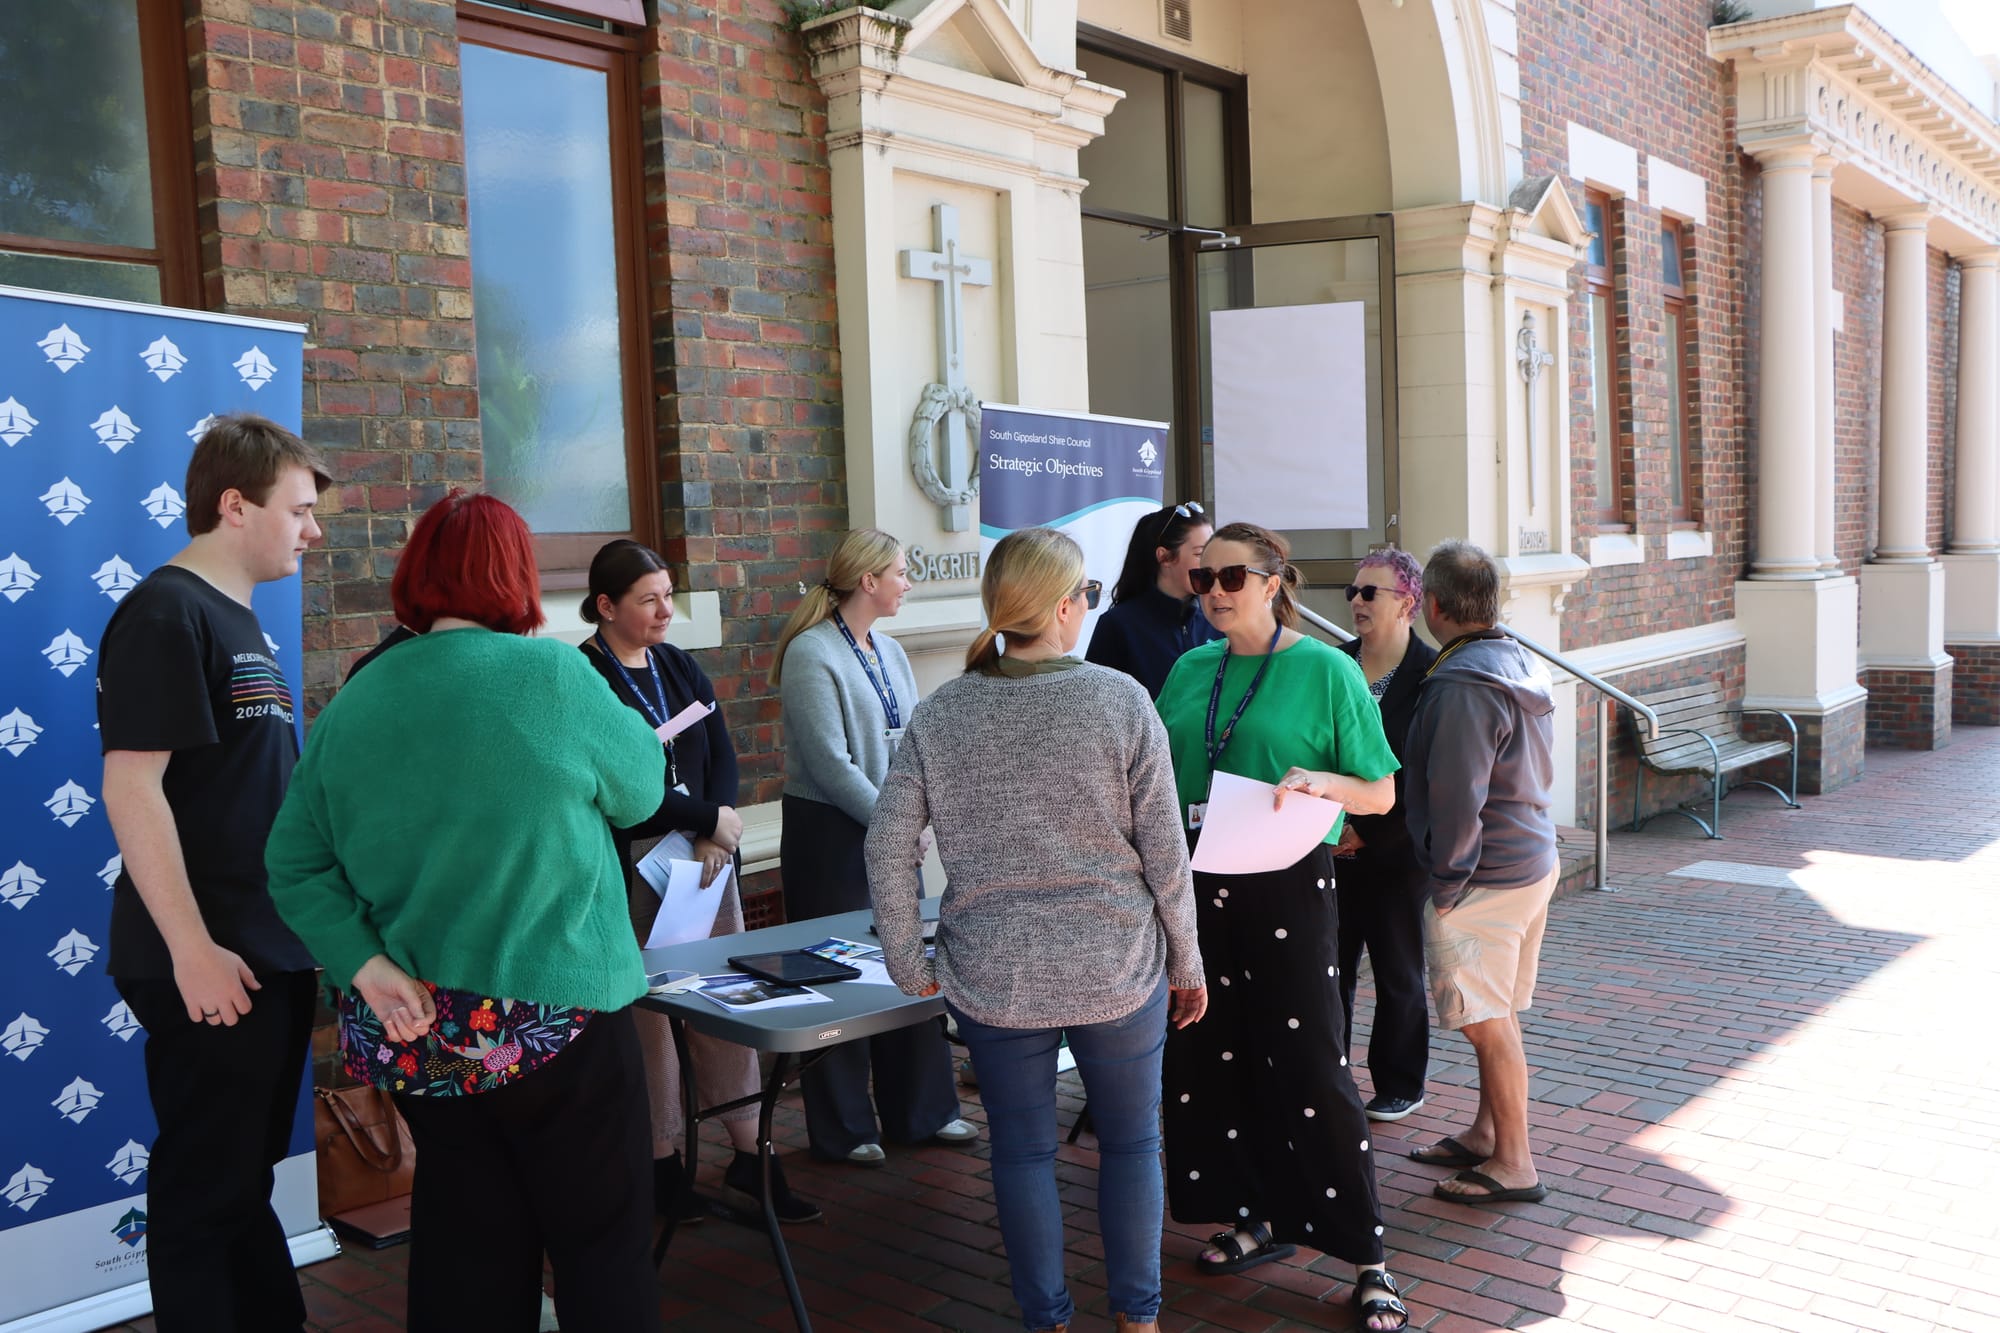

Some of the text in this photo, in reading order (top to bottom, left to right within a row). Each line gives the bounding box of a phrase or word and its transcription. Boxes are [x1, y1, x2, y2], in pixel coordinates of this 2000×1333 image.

[989, 429, 1091, 448] South Gippsland Shire Council
[989, 453, 1104, 479] Strategic Objectives
[236, 704, 269, 720] 2024
[95, 1254, 122, 1269] South
